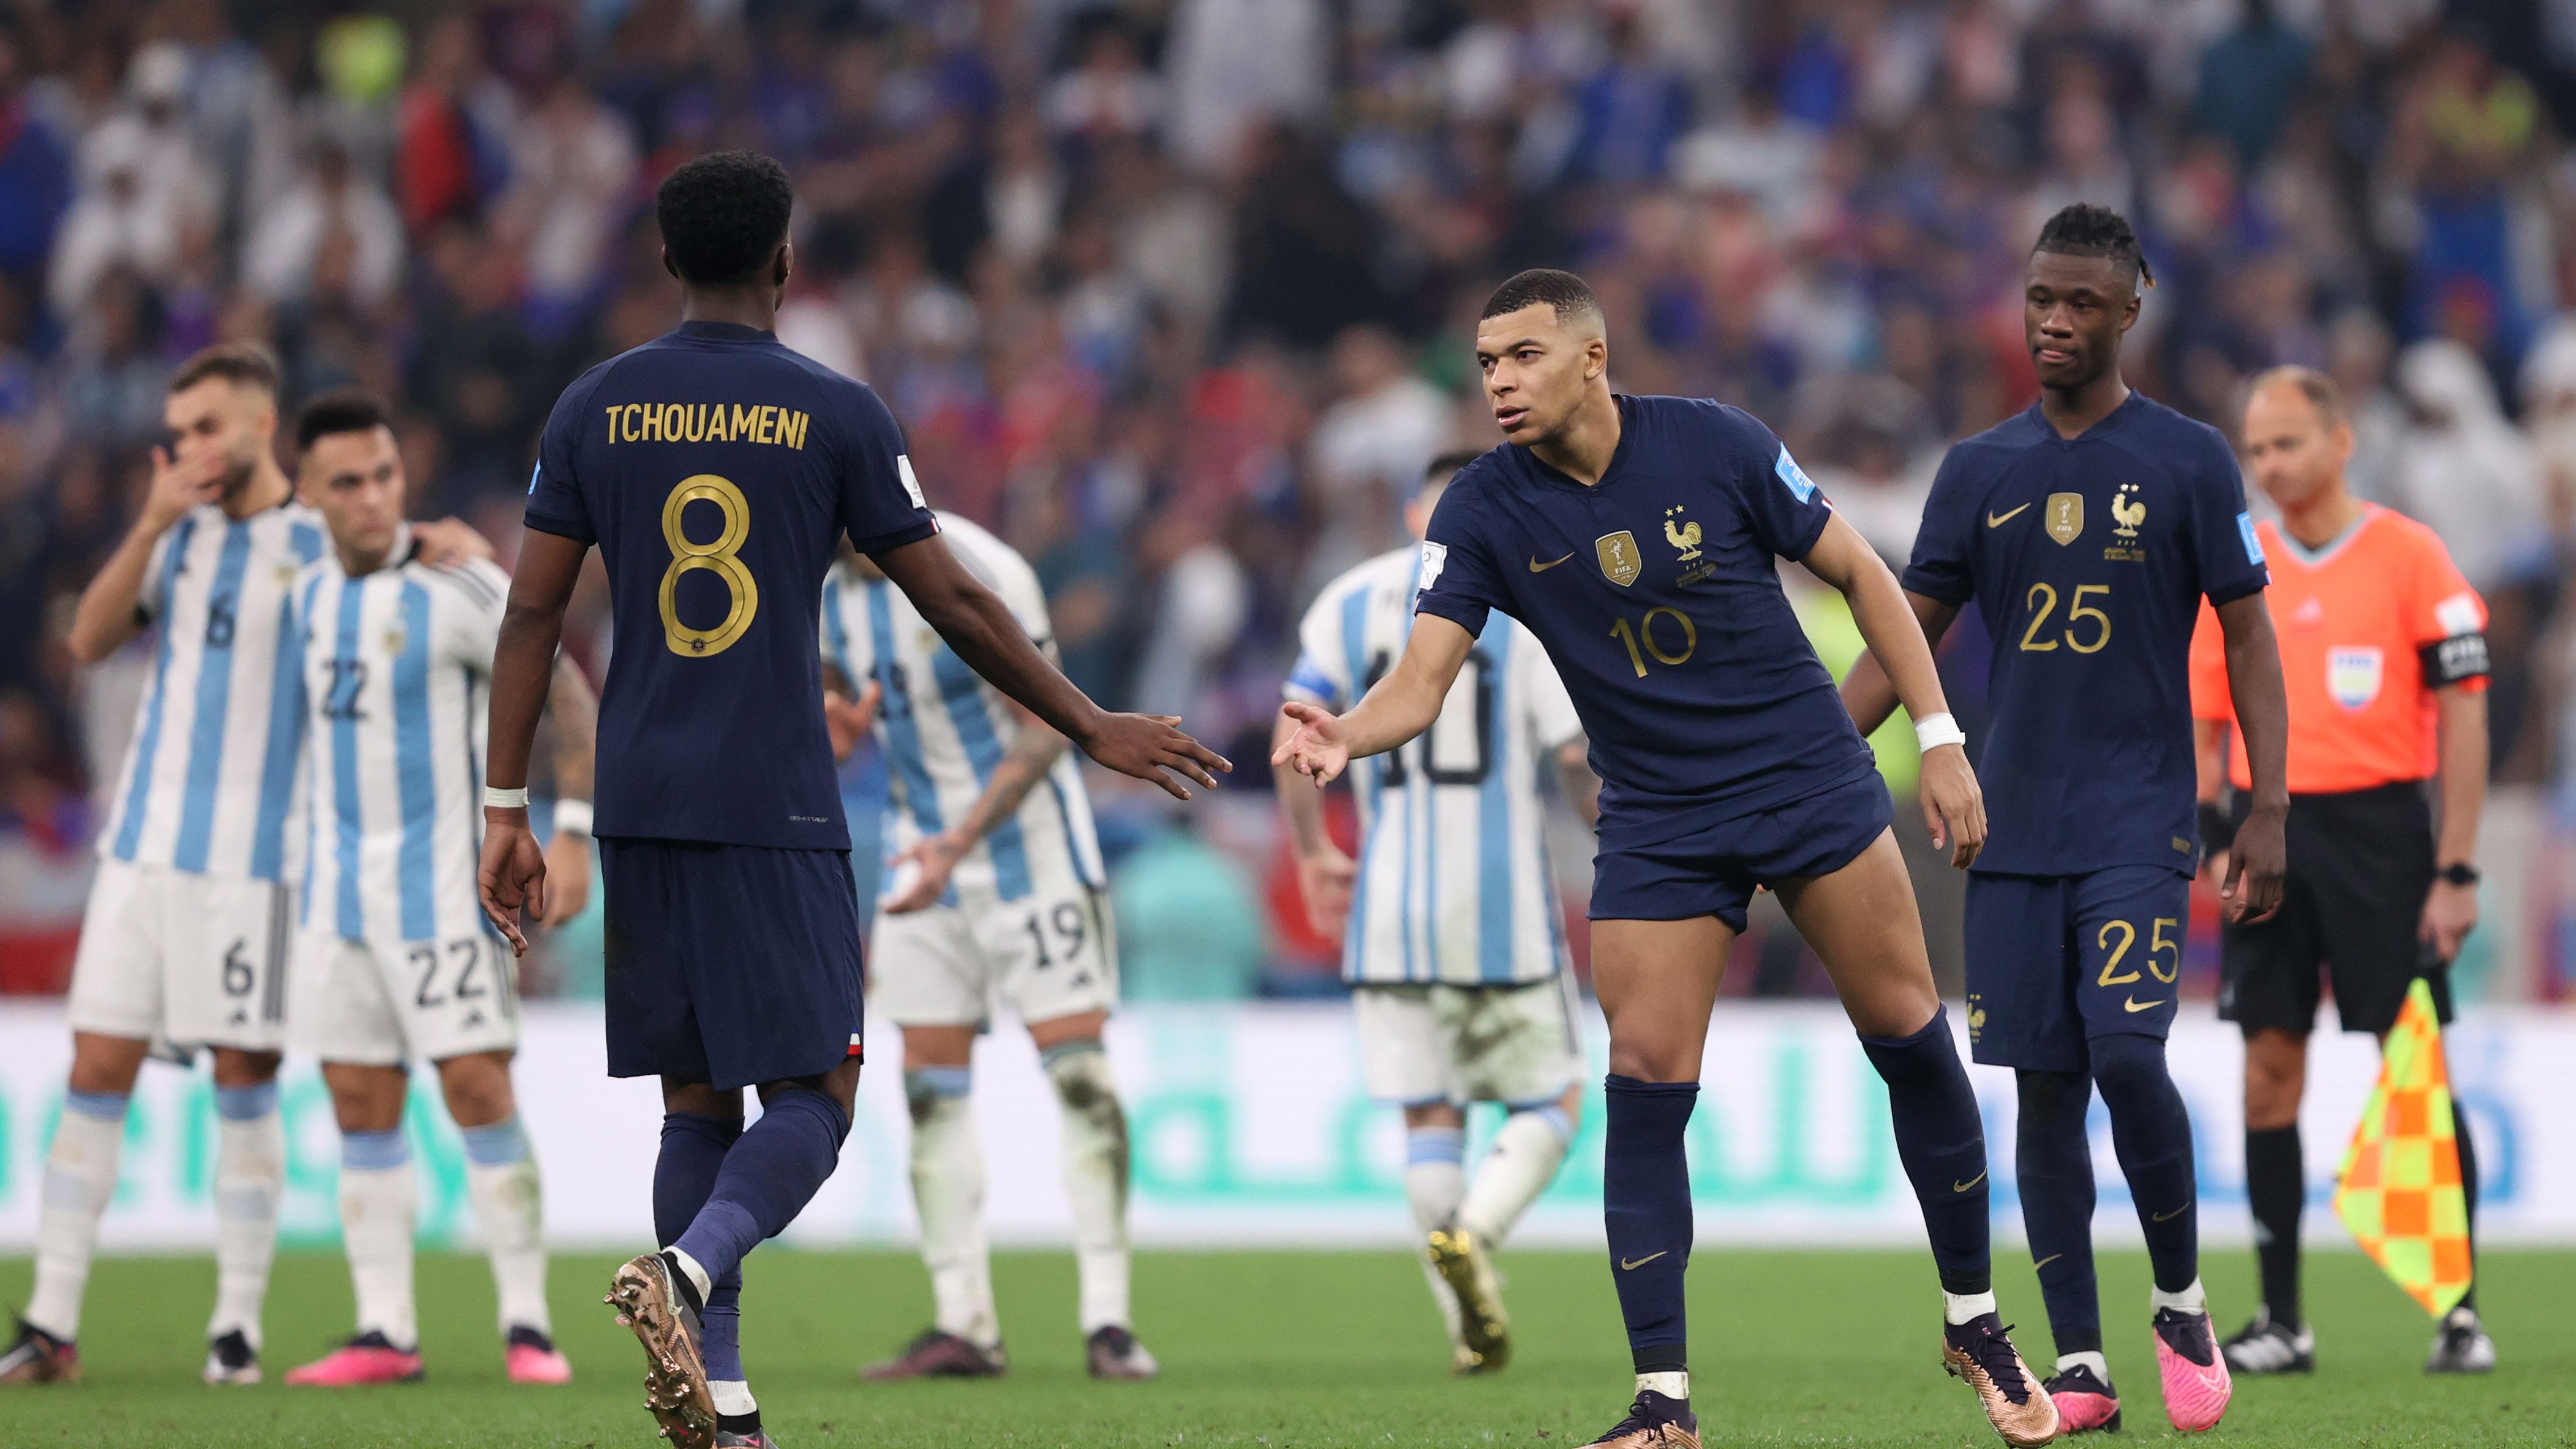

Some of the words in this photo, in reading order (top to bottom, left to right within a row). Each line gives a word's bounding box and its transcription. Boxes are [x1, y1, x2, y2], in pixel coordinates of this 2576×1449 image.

[606, 403, 810, 450] TCHOUAMENI
[658, 474, 758, 657] 8
[1614, 565, 1632, 574] FIFA
[205, 592, 235, 650] 6
[1609, 606, 1697, 679] 10
[2020, 582, 2111, 653] 25
[320, 655, 371, 720] 22
[222, 935, 255, 998] 6
[1025, 900, 1084, 969] 19
[2098, 917, 2179, 987] 25
[408, 937, 488, 1008] 22
